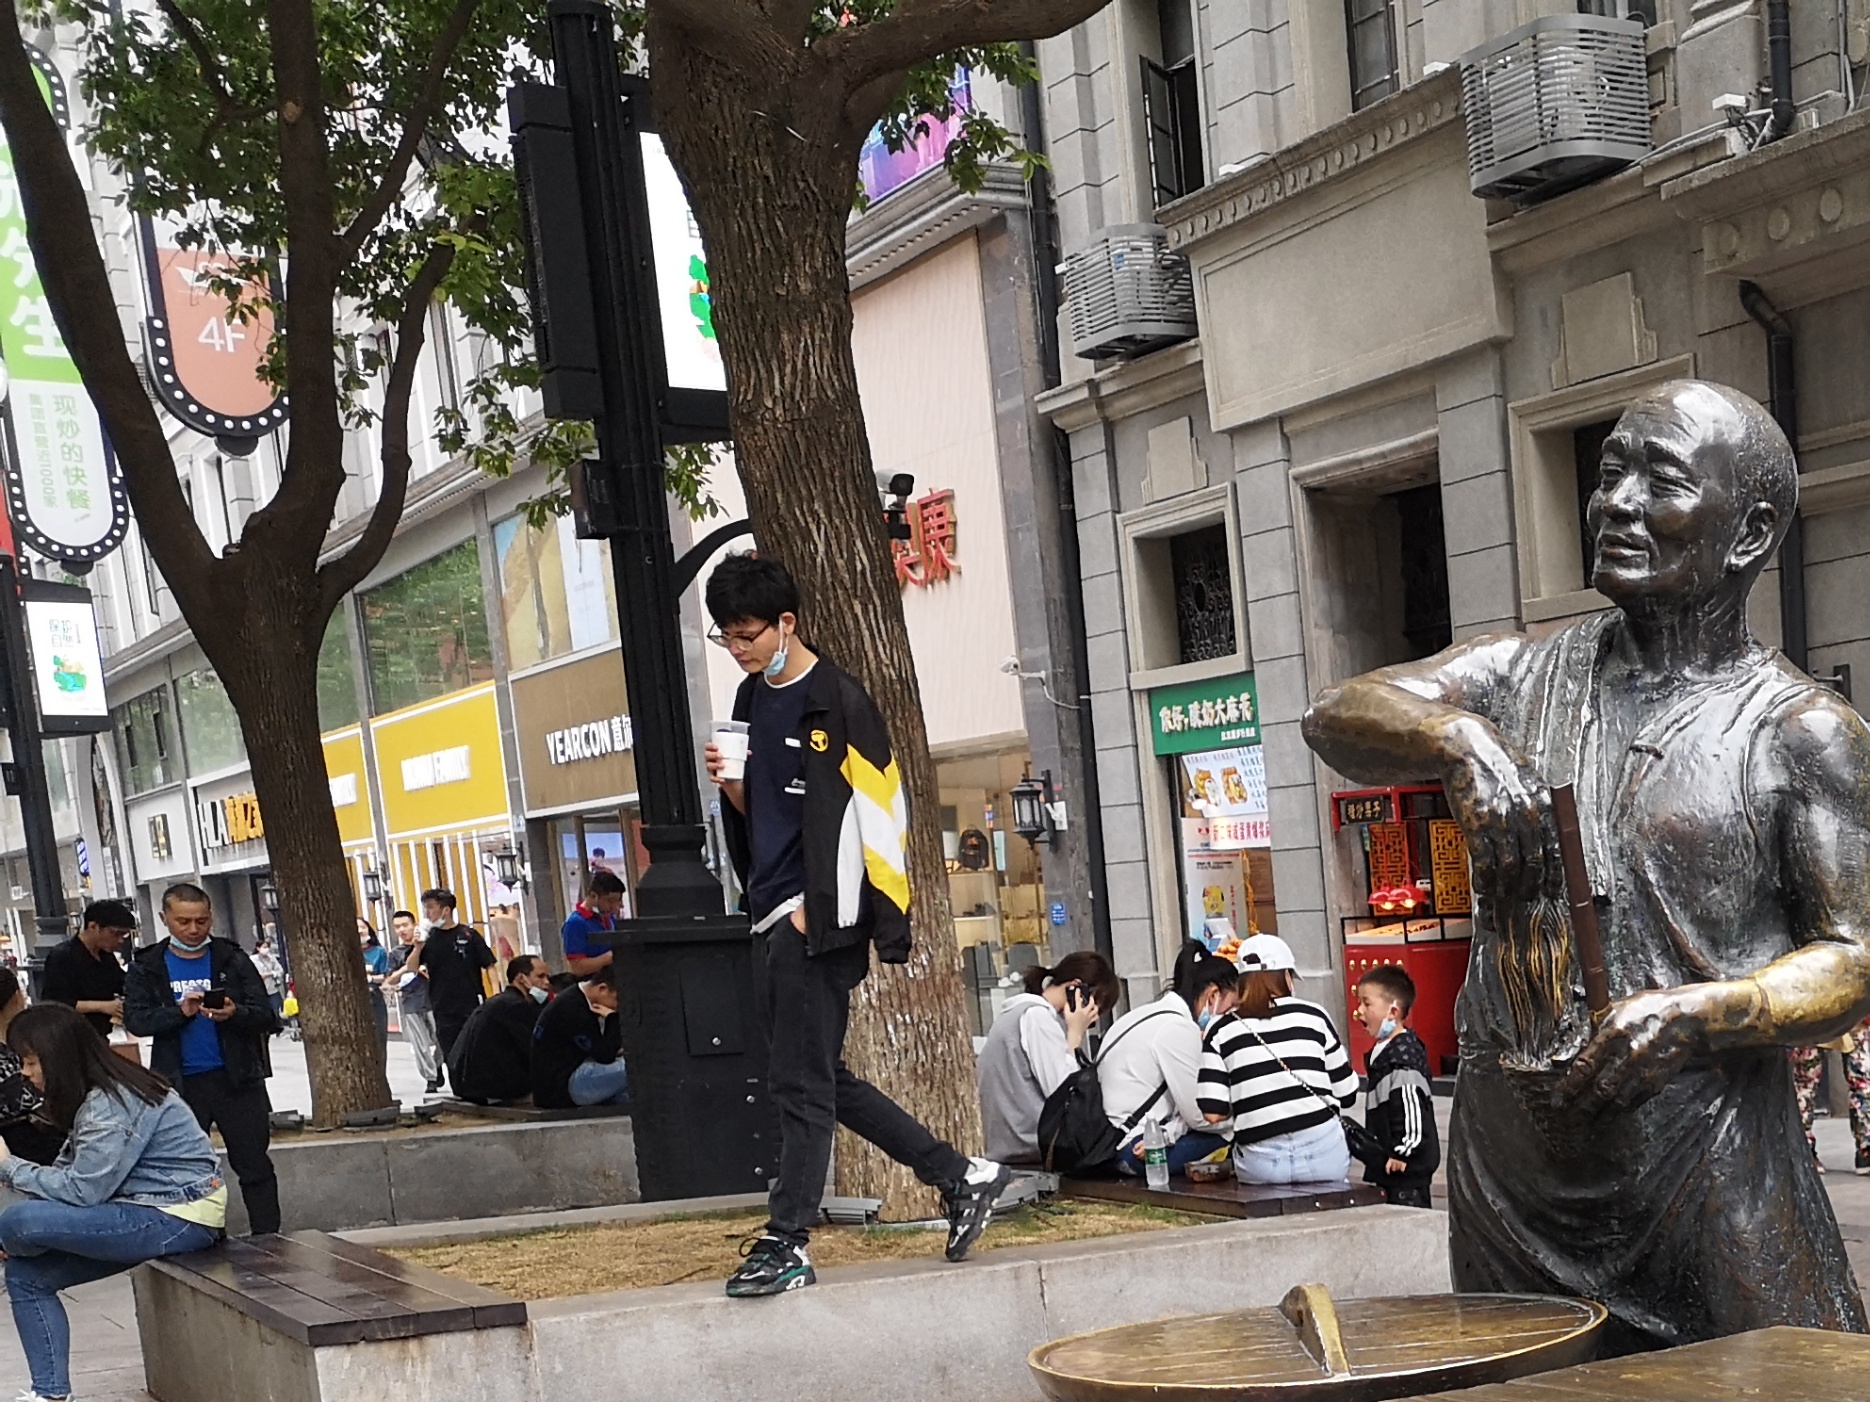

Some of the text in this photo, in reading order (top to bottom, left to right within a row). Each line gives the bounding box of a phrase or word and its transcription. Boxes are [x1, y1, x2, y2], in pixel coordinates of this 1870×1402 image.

[198, 316, 245, 353] 4F
[545, 720, 612, 765] YEARCON
[198, 800, 229, 850] HLA
